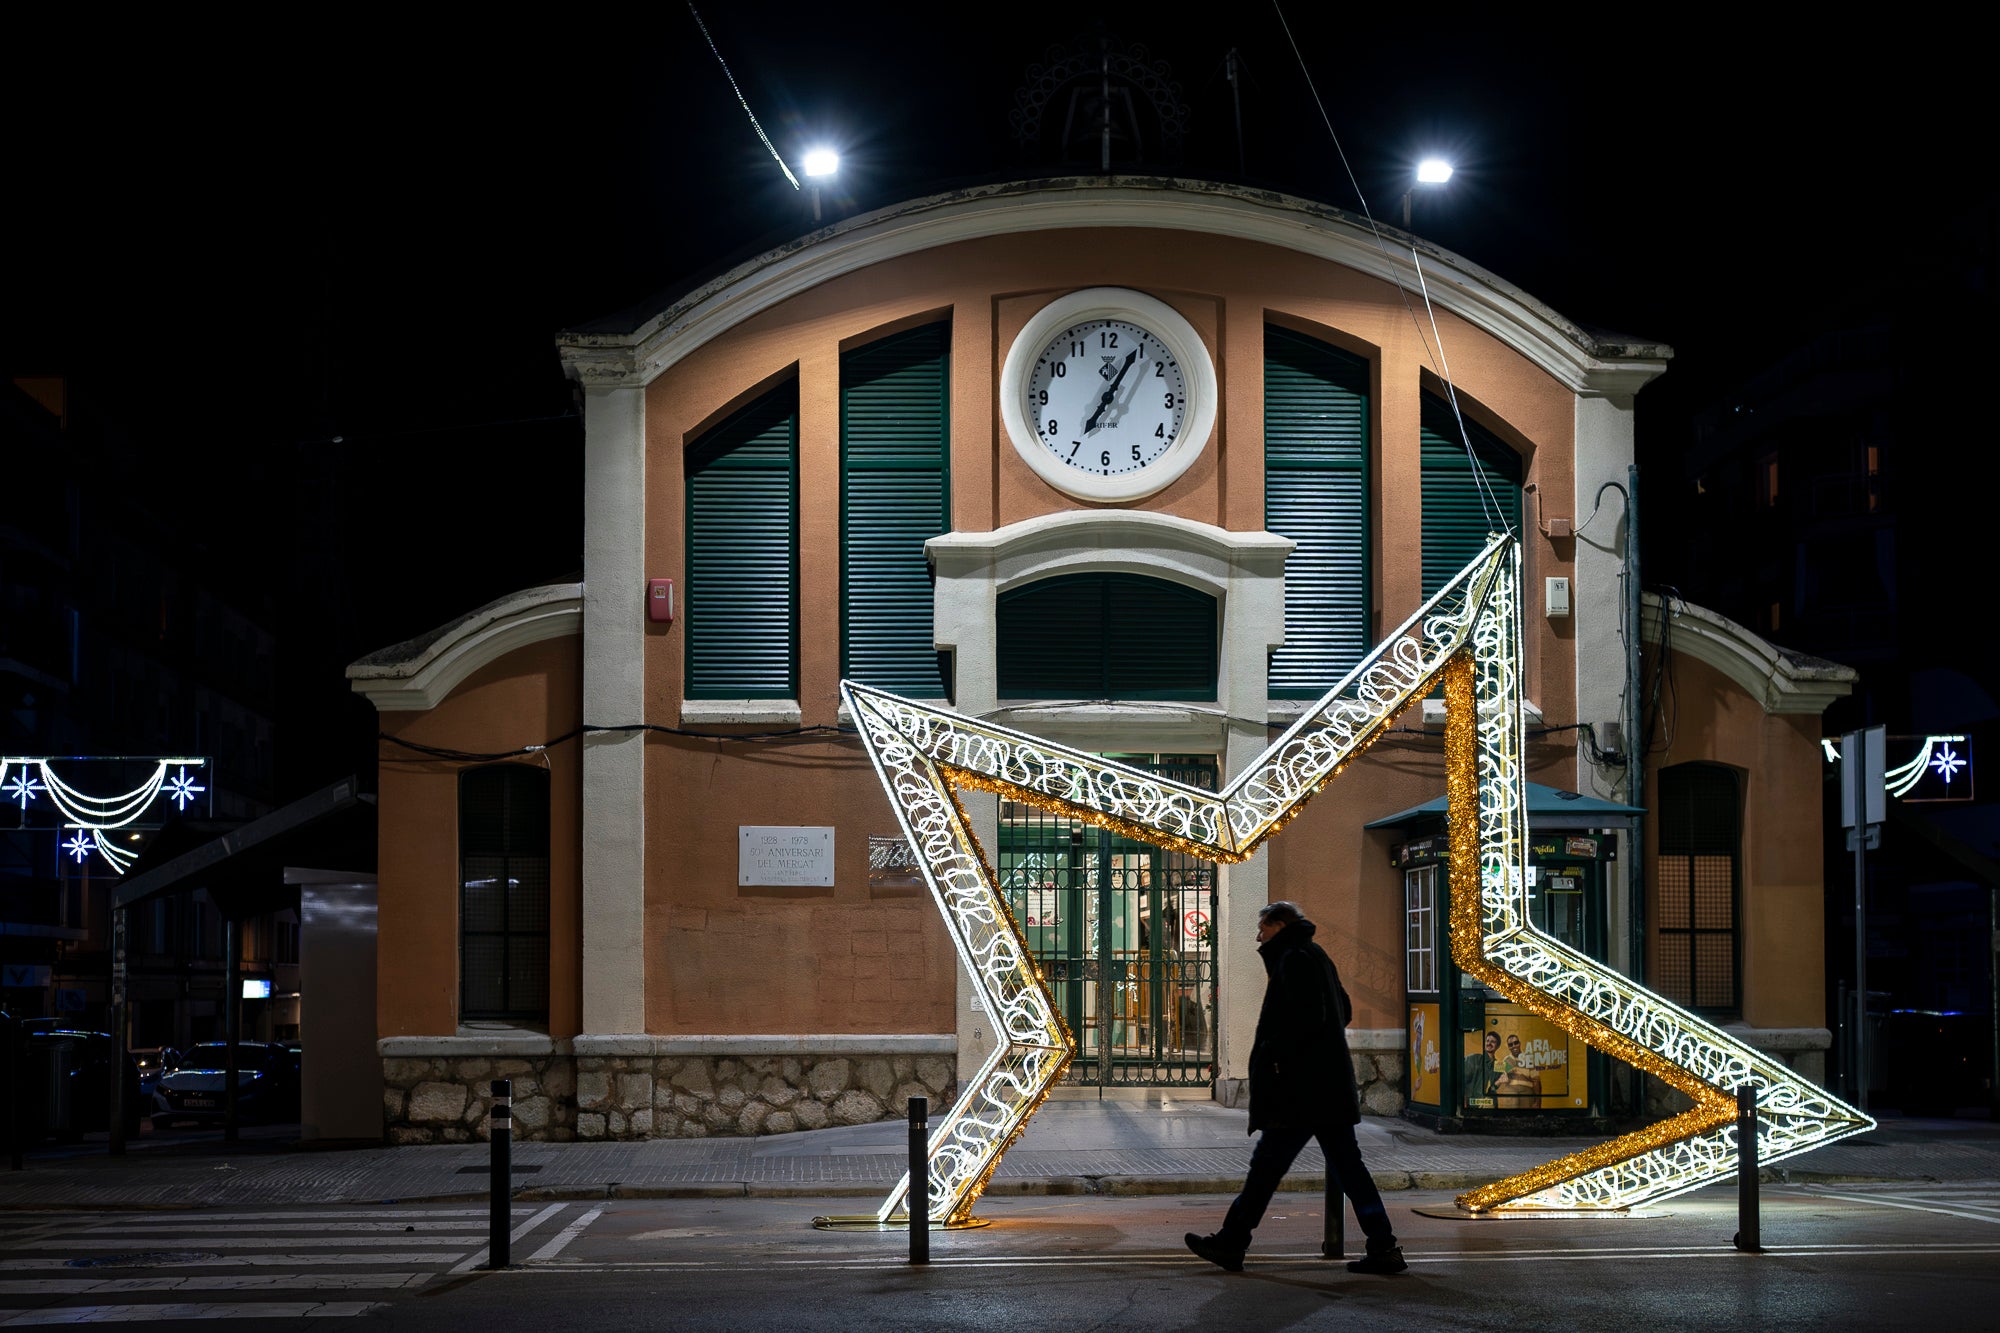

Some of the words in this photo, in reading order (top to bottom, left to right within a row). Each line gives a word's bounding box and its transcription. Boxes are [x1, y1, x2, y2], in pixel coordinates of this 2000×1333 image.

[1101, 332, 1118, 348] 12
[1070, 341, 1084, 357] 11
[1139, 343, 1144, 358] 1
[1049, 361, 1066, 378] 10
[1155, 361, 1164, 377] 2
[1039, 390, 1048, 405] 9
[1165, 393, 1174, 409] 3
[1049, 420, 1057, 435] 8
[1155, 423, 1164, 438] 4
[1071, 441, 1080, 456] 7
[1132, 445, 1141, 461] 5
[1102, 451, 1109, 466] 6
[761, 836, 778, 845] 1928
[791, 836, 809, 845] 1978
[768, 848, 824, 857] ANIVERSARI
[757, 859, 772, 868] DEL
[777, 859, 815, 868] MERCAT
[1517, 1049, 1567, 1069] SEMPRE
